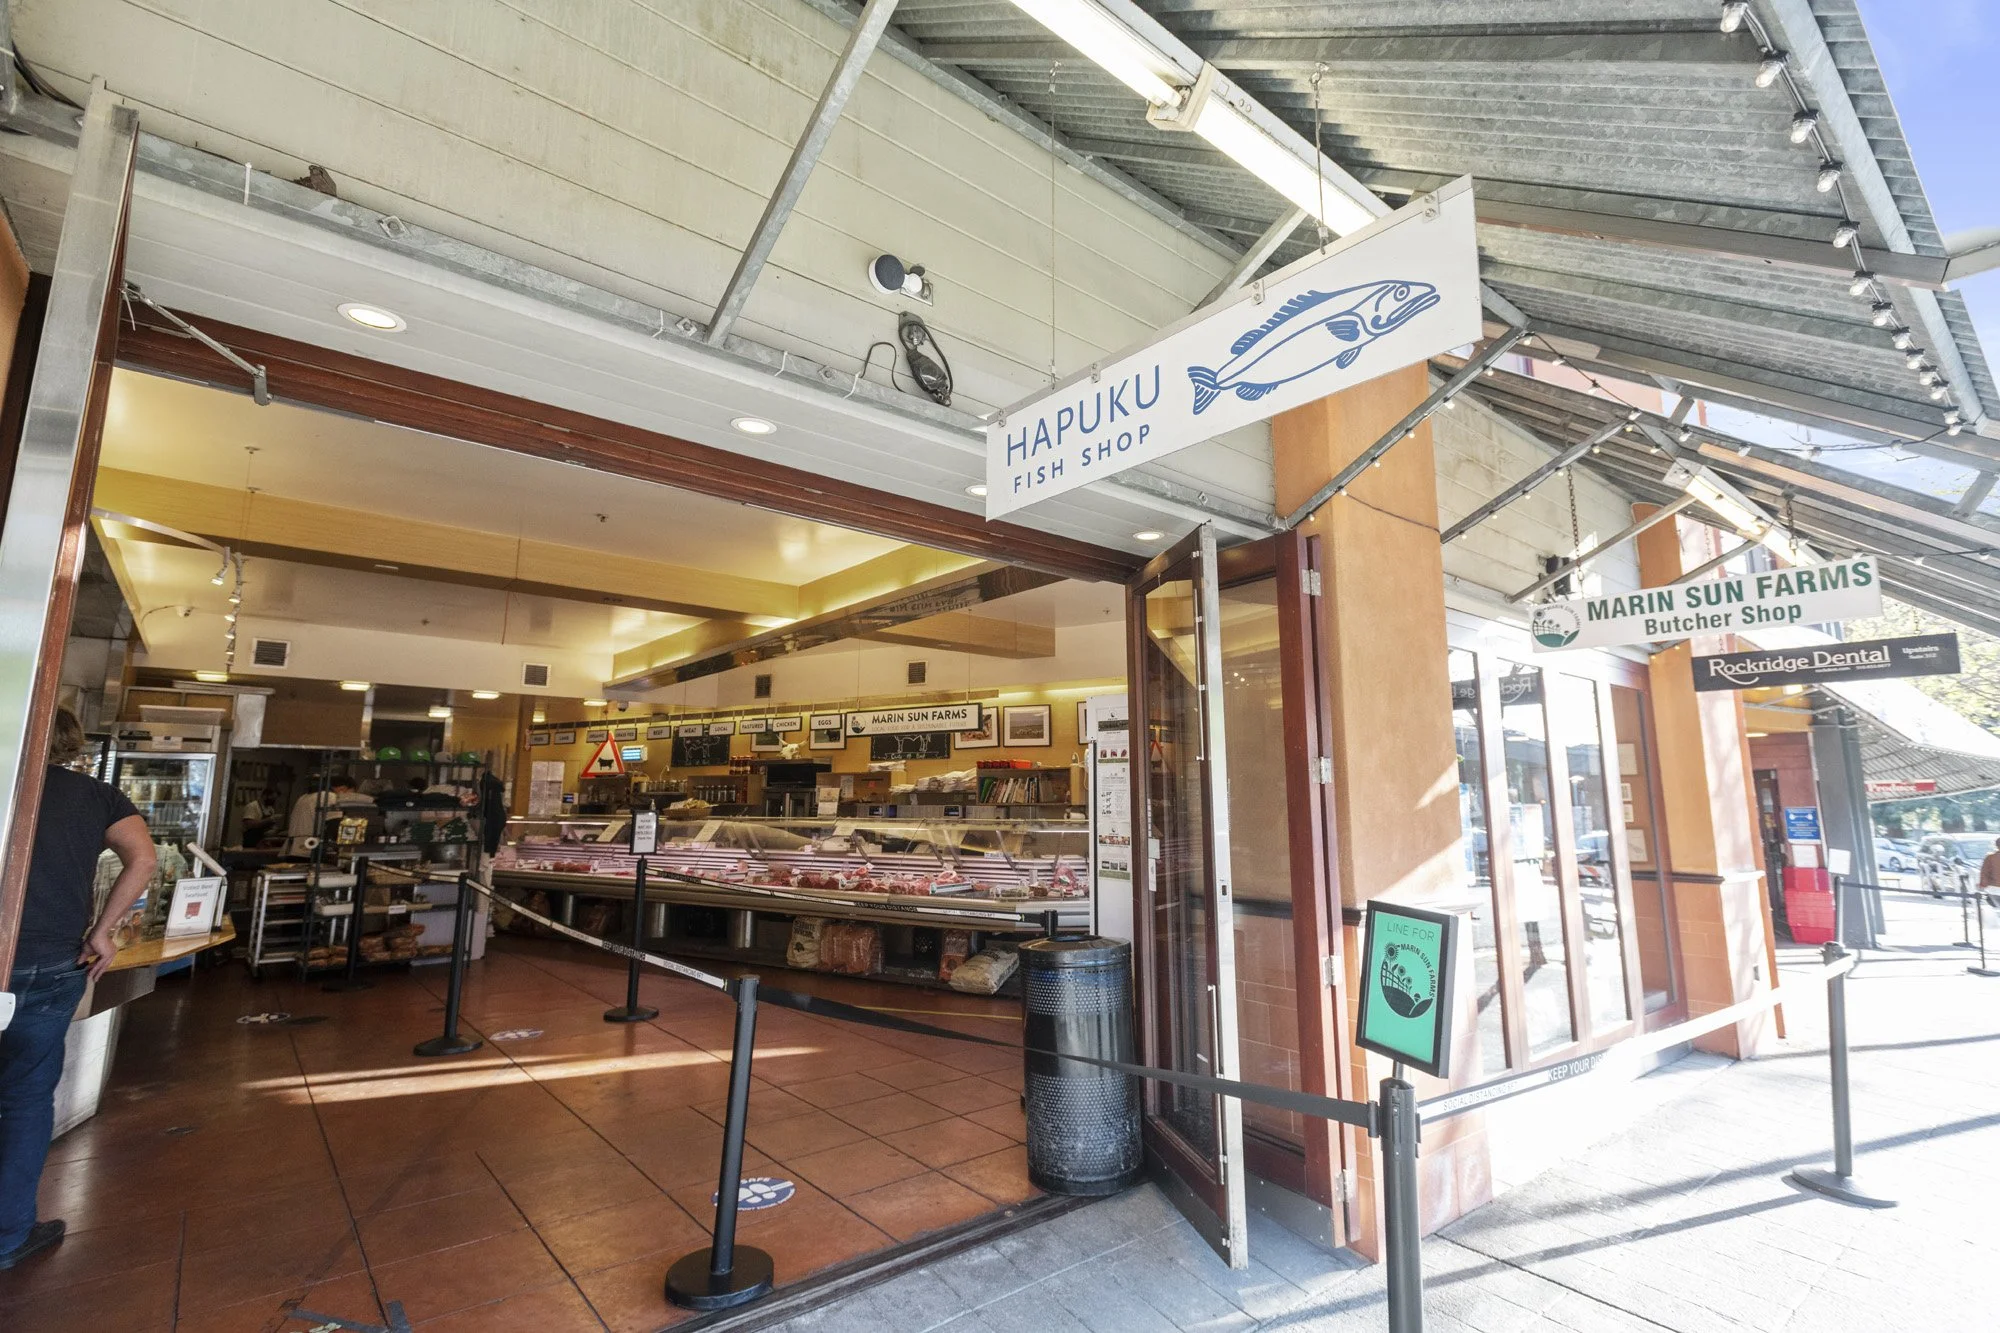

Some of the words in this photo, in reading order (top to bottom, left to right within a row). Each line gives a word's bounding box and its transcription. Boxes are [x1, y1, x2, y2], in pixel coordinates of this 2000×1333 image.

[1007, 365, 1160, 467] HAPUKU
[1014, 458, 1063, 493] FISH
[1081, 424, 1150, 467] SHOP
[1587, 590, 1674, 621] MARIN
[1686, 580, 1744, 609] SUN
[1757, 562, 1873, 599] FARMS
[1645, 611, 1732, 636] Butcher
[1742, 604, 1802, 624] Shop
[1709, 656, 1810, 684] Rockridge
[1813, 645, 1891, 666] Dental
[872, 714, 904, 724] MARIN
[908, 711, 928, 722] SUN
[932, 709, 967, 720] FARMS
[1387, 922, 1409, 936] LINE
[1412, 928, 1435, 942] FOR
[1401, 943, 1420, 956] MARIN
[1420, 952, 1431, 969] SUN
[1429, 969, 1437, 997] FARMS
[1547, 1065, 1568, 1081] KEEP
[1569, 1058, 1590, 1075] YOUR
